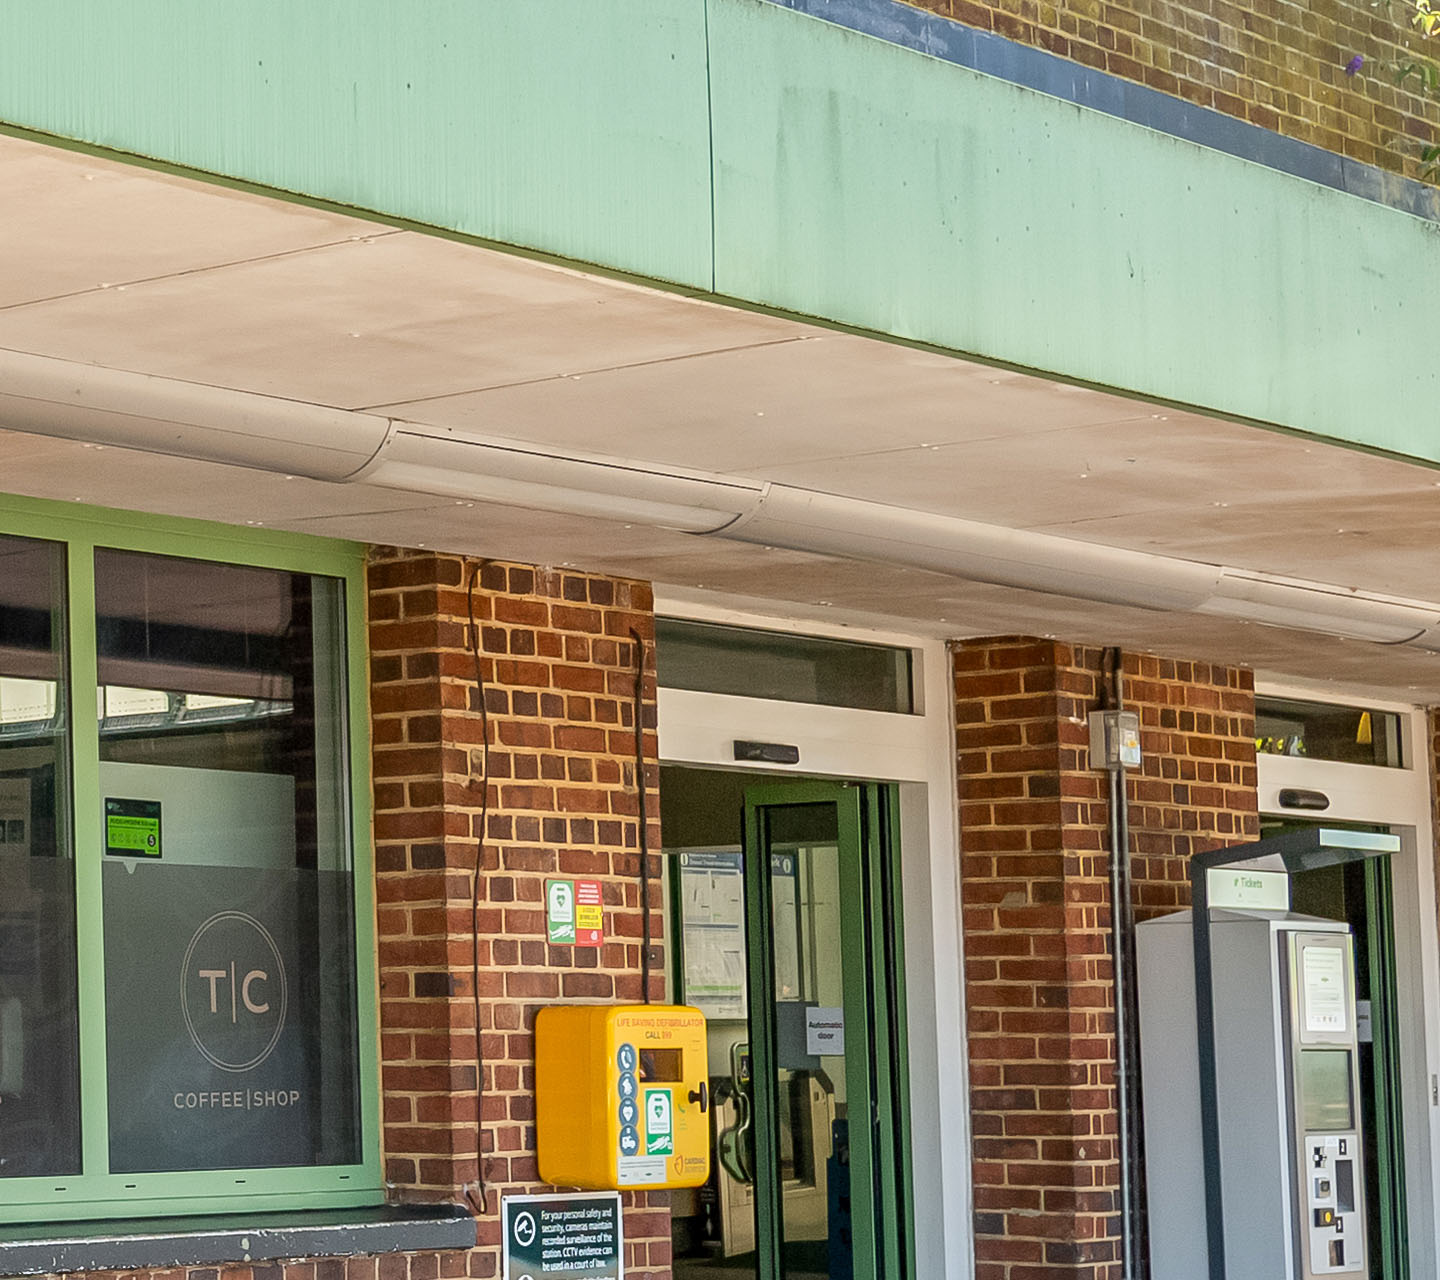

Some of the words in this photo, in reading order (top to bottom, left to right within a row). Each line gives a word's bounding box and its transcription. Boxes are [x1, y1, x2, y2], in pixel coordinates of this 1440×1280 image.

[1241, 877, 1263, 889] Tickets
[645, 1030, 660, 1040] CALL
[818, 1032, 834, 1040] door
[563, 1247, 578, 1257] CCTV
